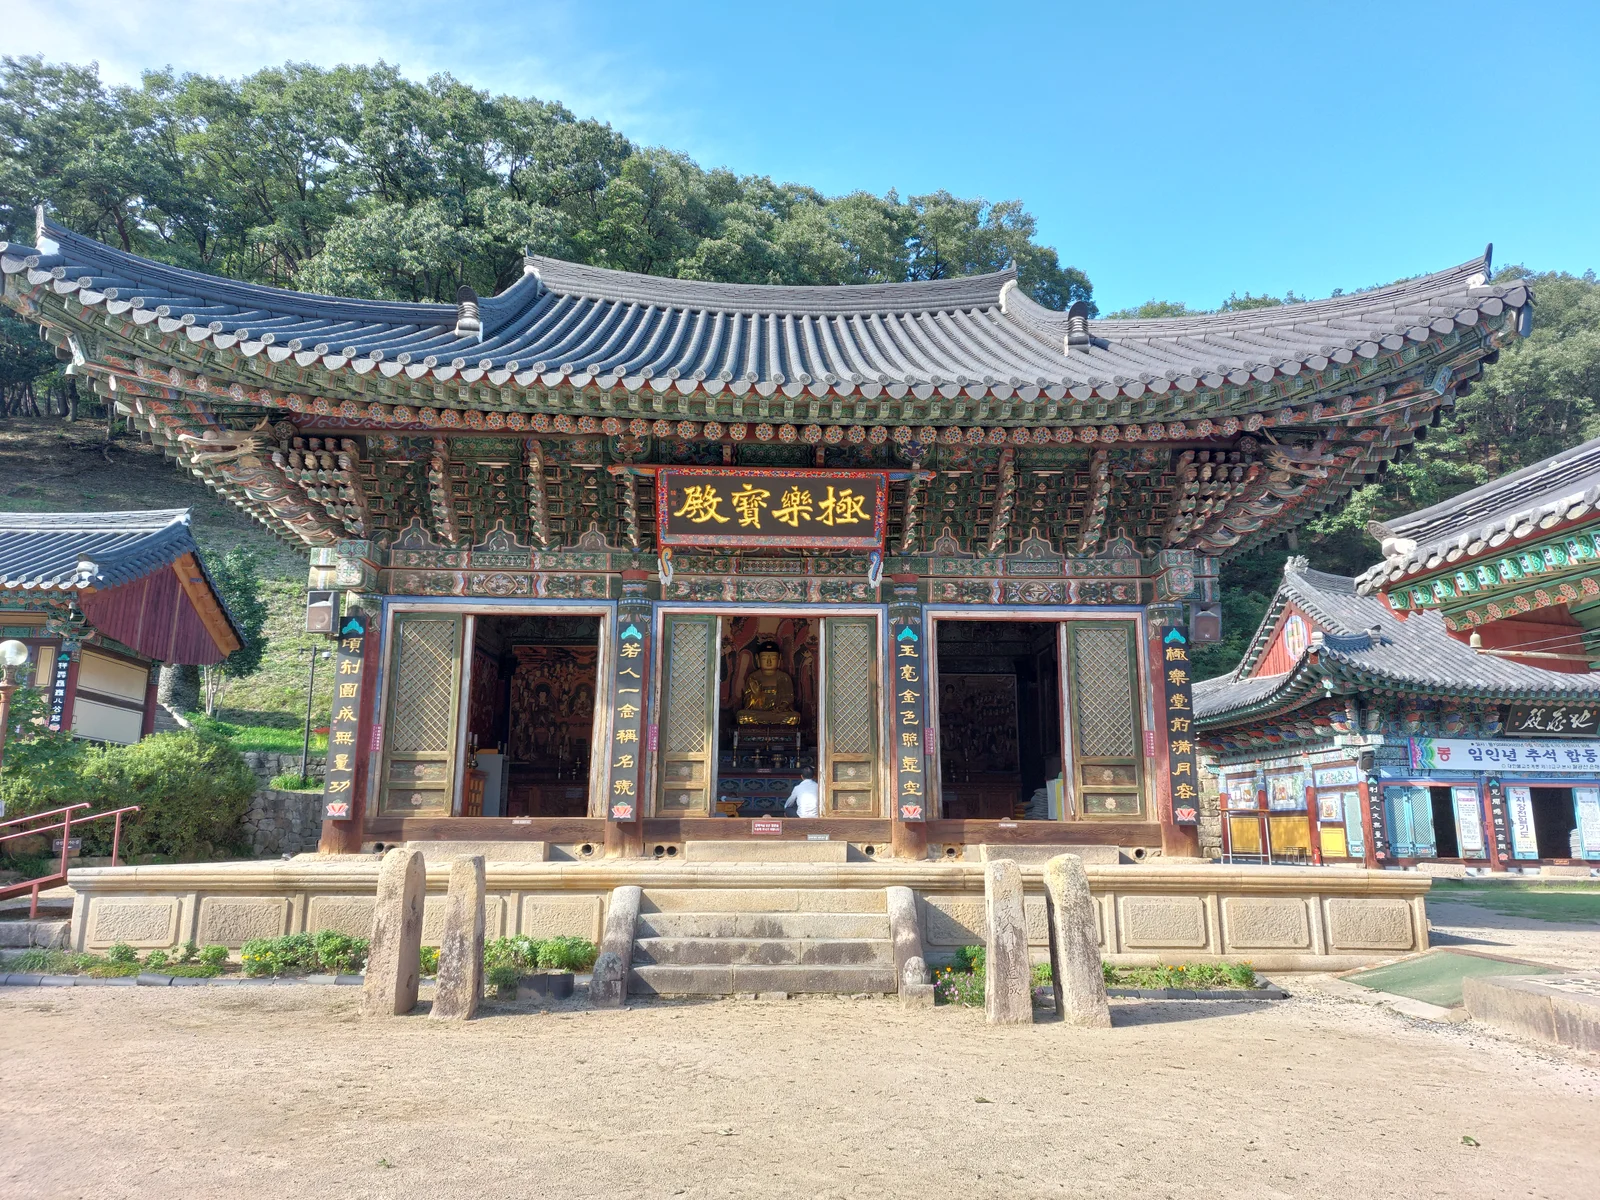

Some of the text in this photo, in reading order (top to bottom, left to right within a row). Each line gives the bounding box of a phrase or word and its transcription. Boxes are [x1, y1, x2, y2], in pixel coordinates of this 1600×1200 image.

[1437, 746, 1451, 762] 봉
[1468, 747, 1598, 763] 임인년 추석 합동
